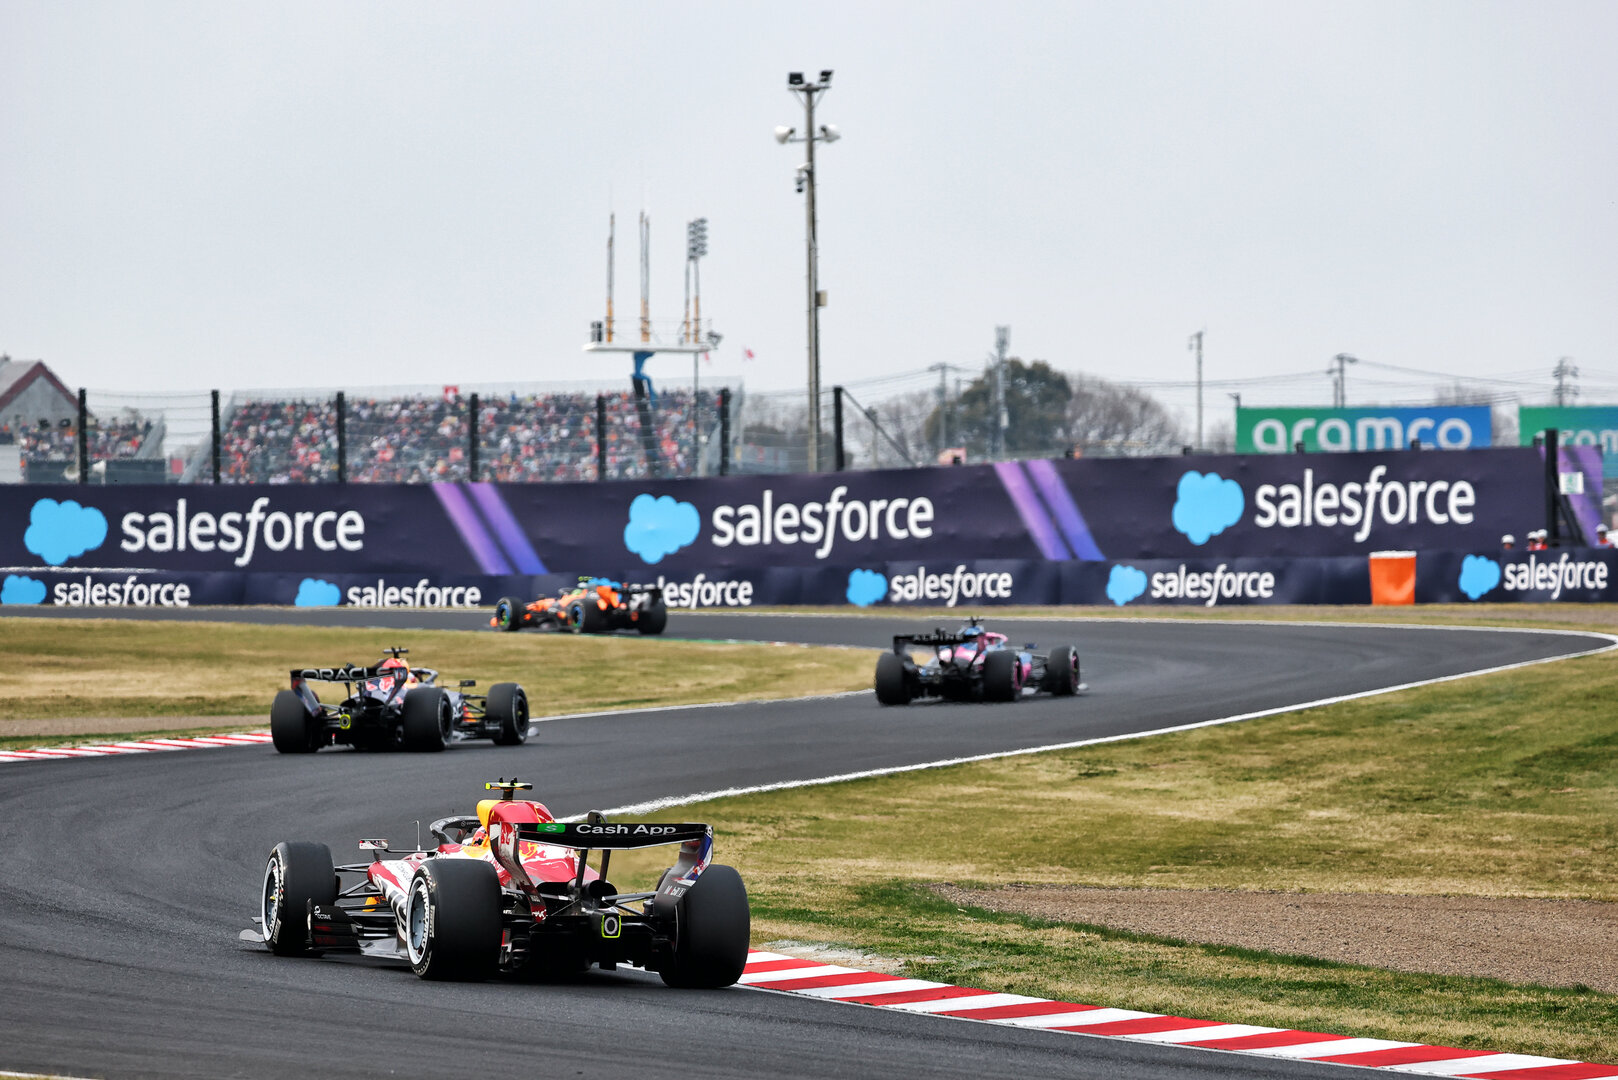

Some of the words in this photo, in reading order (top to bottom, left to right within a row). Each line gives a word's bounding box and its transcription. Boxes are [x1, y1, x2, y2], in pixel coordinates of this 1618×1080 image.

[1252, 417, 1472, 452] aramco
[712, 486, 934, 559] salesforce
[1255, 465, 1475, 543] salesforce
[120, 497, 365, 567] salesforce
[53, 575, 191, 608] salesforce
[347, 579, 481, 608] salesforce
[891, 564, 1013, 608] salesforce
[1151, 563, 1275, 608] salesforce
[1504, 552, 1608, 600] salesforce
[576, 824, 629, 835] Cash
[633, 824, 677, 836] App
